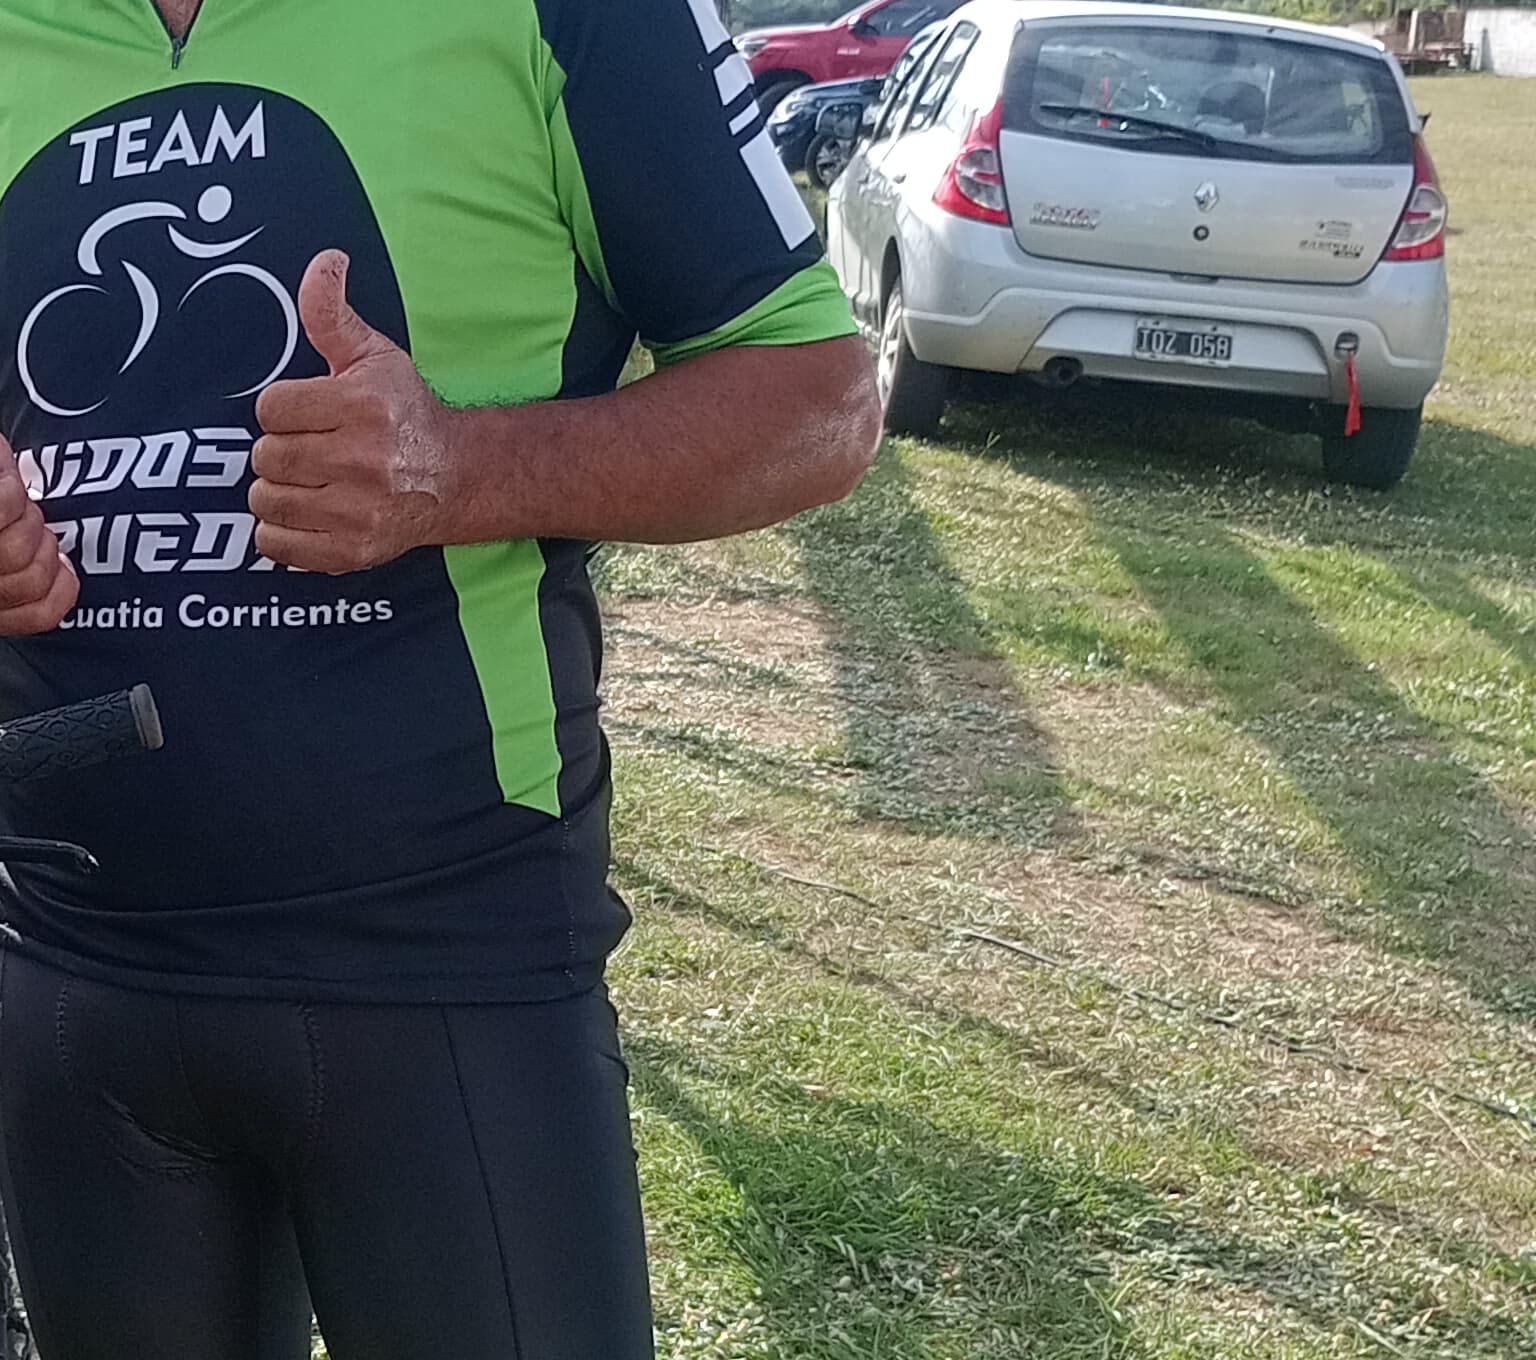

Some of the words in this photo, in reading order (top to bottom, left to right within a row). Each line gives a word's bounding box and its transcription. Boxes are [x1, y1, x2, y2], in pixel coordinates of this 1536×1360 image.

[69, 99, 266, 185] TEAM
[1190, 334, 1229, 359] 058
[177, 592, 394, 629] Corrientes
